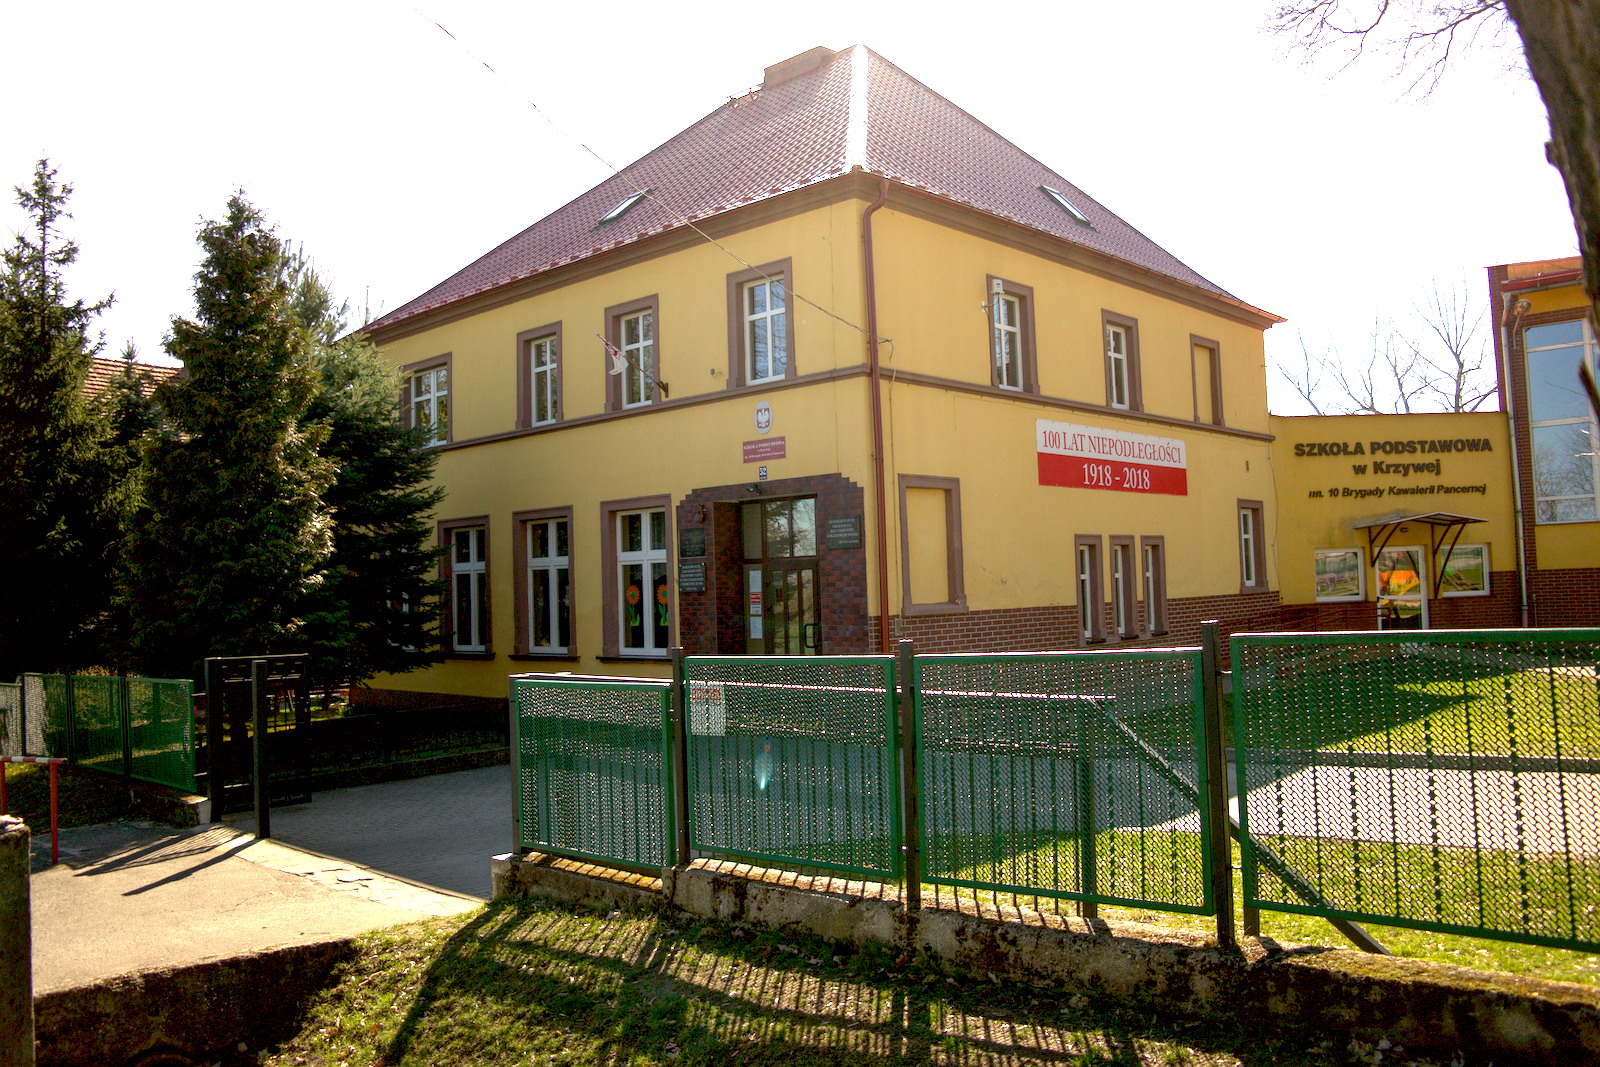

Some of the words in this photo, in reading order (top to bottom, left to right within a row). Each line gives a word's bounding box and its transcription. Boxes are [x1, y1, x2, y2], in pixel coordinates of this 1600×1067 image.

[1042, 430, 1061, 449] 100
[1062, 431, 1085, 451] LAT
[1088, 435, 1181, 464] NIEPODLEGŁOŚCI
[1294, 441, 1366, 457] SZKOŁA
[1370, 438, 1493, 455] PODSTAWOWA
[1082, 462, 1112, 487] 1918
[1122, 467, 1151, 490] 2018
[1352, 463, 1367, 475] w
[1373, 459, 1441, 476] Krzywej
[1328, 488, 1339, 497] 10
[1341, 486, 1385, 499] Brygady
[1388, 485, 1435, 496] Kawalerii
[1436, 483, 1487, 496] Pancernej
